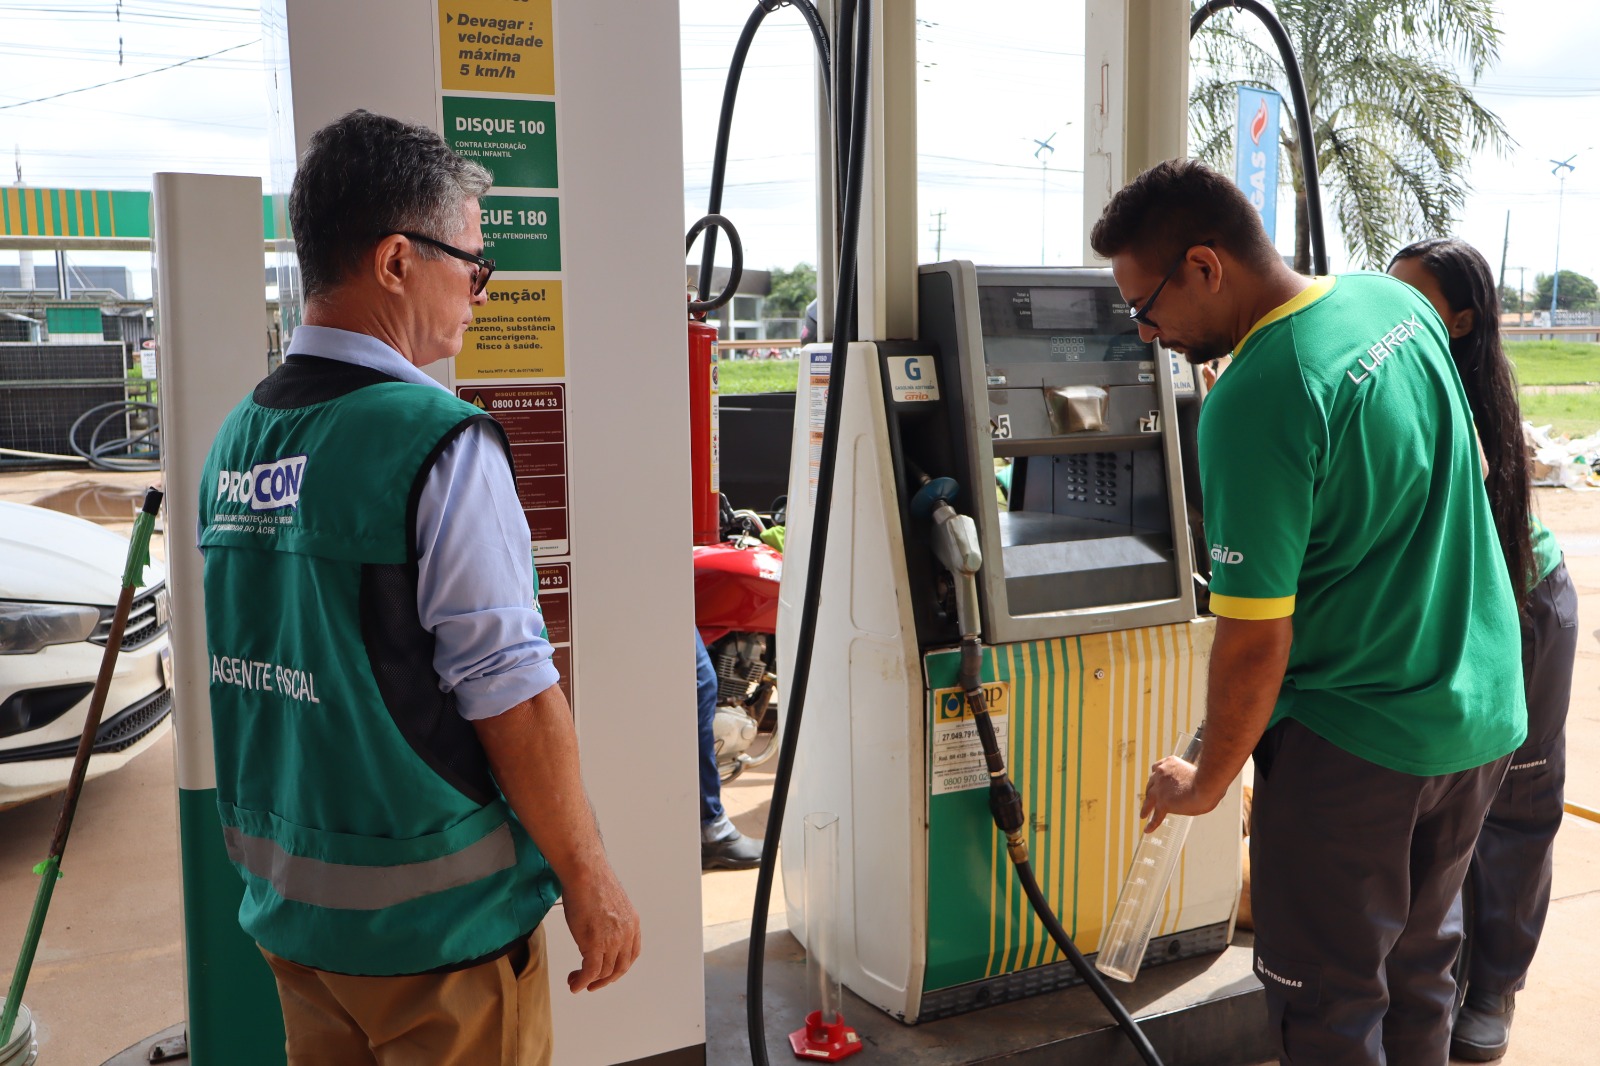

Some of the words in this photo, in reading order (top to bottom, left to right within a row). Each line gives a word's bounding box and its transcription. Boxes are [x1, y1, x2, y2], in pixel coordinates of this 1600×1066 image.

[457, 13, 524, 31] Devagar
[458, 32, 543, 48] velocidade
[459, 48, 521, 62] máxima
[460, 64, 470, 76] 5
[475, 65, 516, 79] km/h
[455, 117, 515, 136] DISQUE
[519, 120, 545, 135] 100
[484, 142, 527, 150] EXPLORAÇÃO
[1250, 151, 1266, 213] GAS
[480, 209, 513, 225] GUE
[518, 210, 547, 226] 180
[486, 289, 546, 304] enção!
[475, 315, 514, 325] gasolina
[516, 315, 551, 323] contém
[465, 325, 504, 333] enzeno,
[506, 324, 556, 332] substância
[479, 333, 539, 342] cancerígena.
[476, 342, 502, 350] Risco
[504, 342, 511, 350] à
[513, 342, 543, 350] saúde.
[904, 357, 922, 381] G
[492, 399, 513, 409] 0800
[514, 399, 521, 408] 0
[522, 399, 532, 408] 24
[534, 398, 545, 407] 44
[547, 398, 558, 407] 33
[217, 463, 302, 504] PROCON
[540, 577, 551, 586] 44
[552, 576, 563, 585] 33
[212, 654, 273, 691] AGENTE
[1510, 758, 1547, 771] PETROBRAS
[944, 777, 962, 787] 0800
[964, 774, 977, 784] 970
[979, 772, 990, 781] 02
[1264, 968, 1303, 988] PETROBRAS
